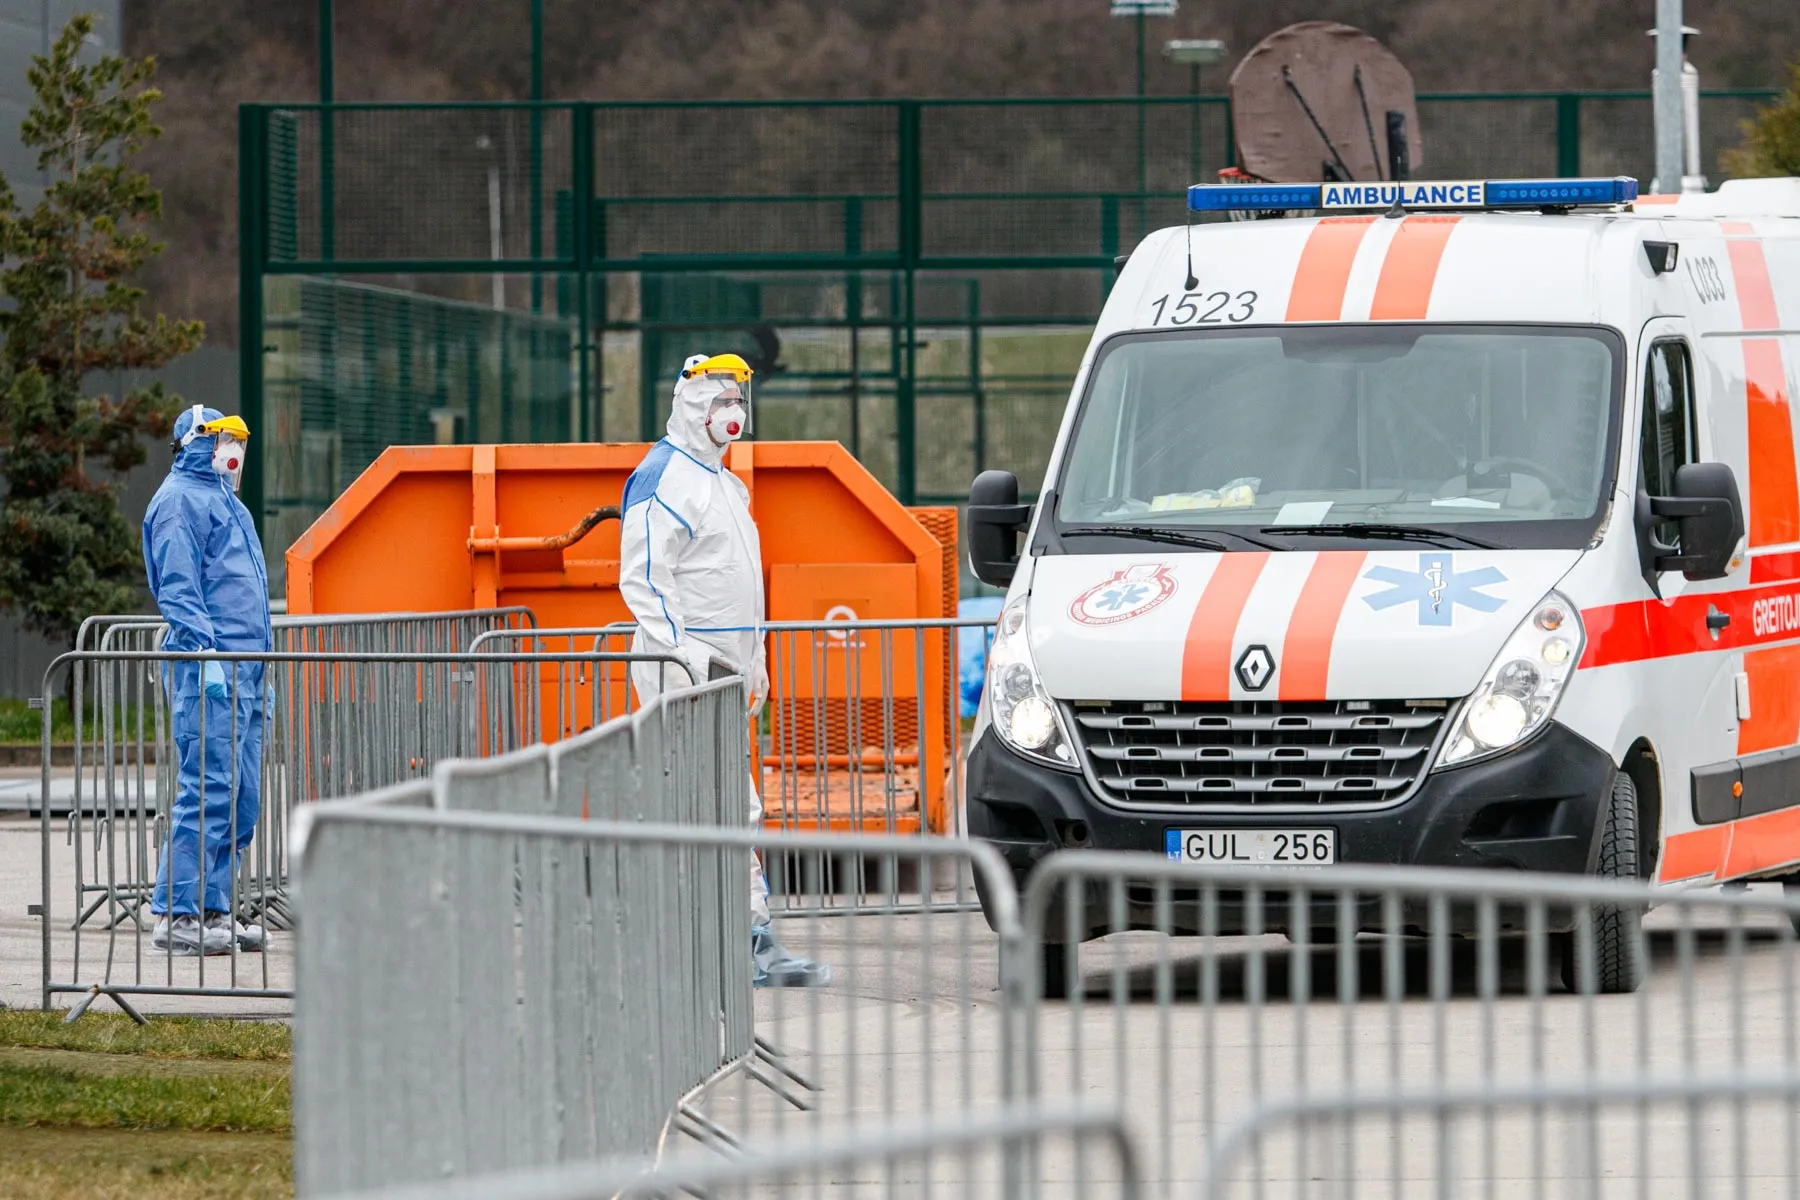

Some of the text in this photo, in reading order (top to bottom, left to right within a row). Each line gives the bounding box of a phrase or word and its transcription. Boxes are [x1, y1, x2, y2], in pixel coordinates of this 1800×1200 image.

[1325, 185, 1481, 205] AMBULANCE
[1152, 290, 1258, 326] 1523
[1167, 851, 1181, 860] LT
[1186, 834, 1329, 861] GUL 256
